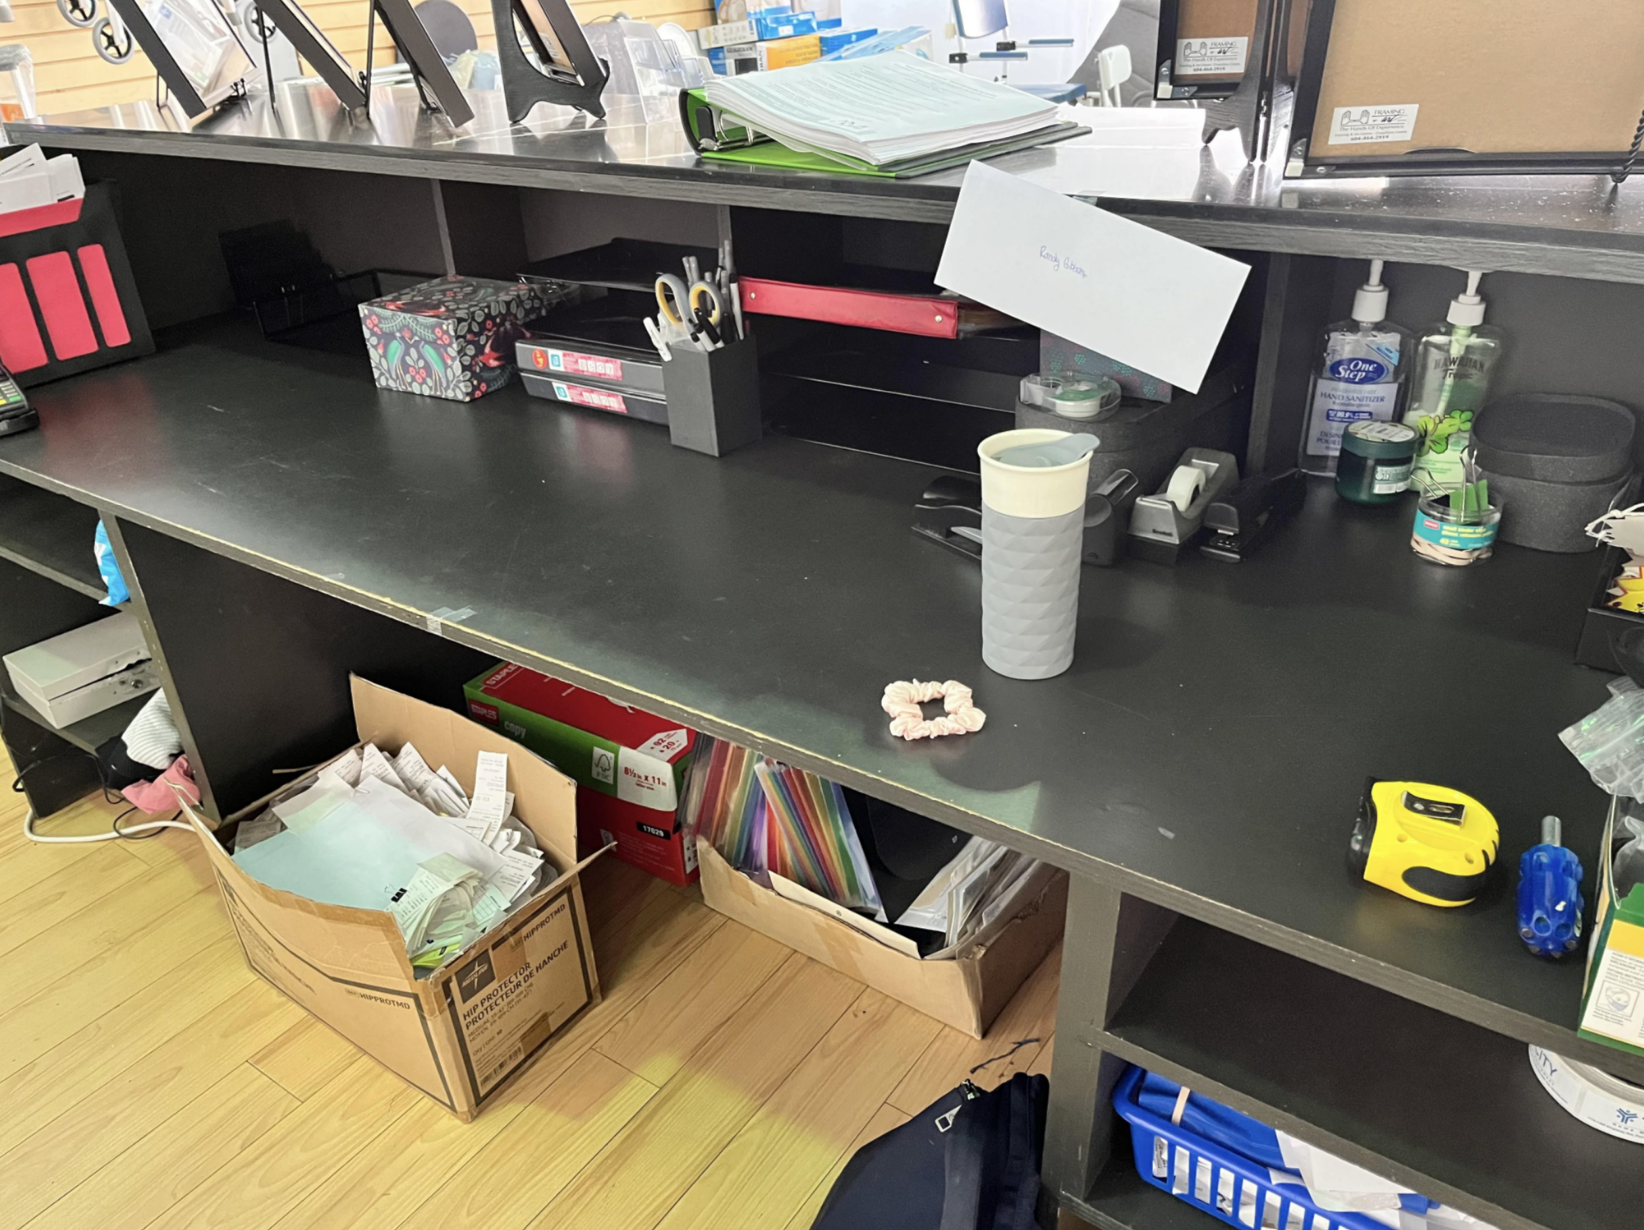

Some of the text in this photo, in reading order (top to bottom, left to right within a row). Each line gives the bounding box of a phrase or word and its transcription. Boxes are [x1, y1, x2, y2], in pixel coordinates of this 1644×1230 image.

[1335, 365, 1366, 381] Step
[1350, 360, 1378, 371] One
[1320, 392, 1345, 400] HAND
[486, 663, 519, 685] STAPLE
[471, 703, 497, 720] STAPLES
[504, 721, 526, 739] copy
[523, 904, 566, 941] HIPPROTMD
[463, 962, 531, 1021] HIP PROTECTOR
[466, 980, 522, 1030] PROTECTEUR
[523, 968, 535, 984] DE
[535, 940, 568, 973] HANCHE
[359, 993, 410, 1009] HIPPROTMD
